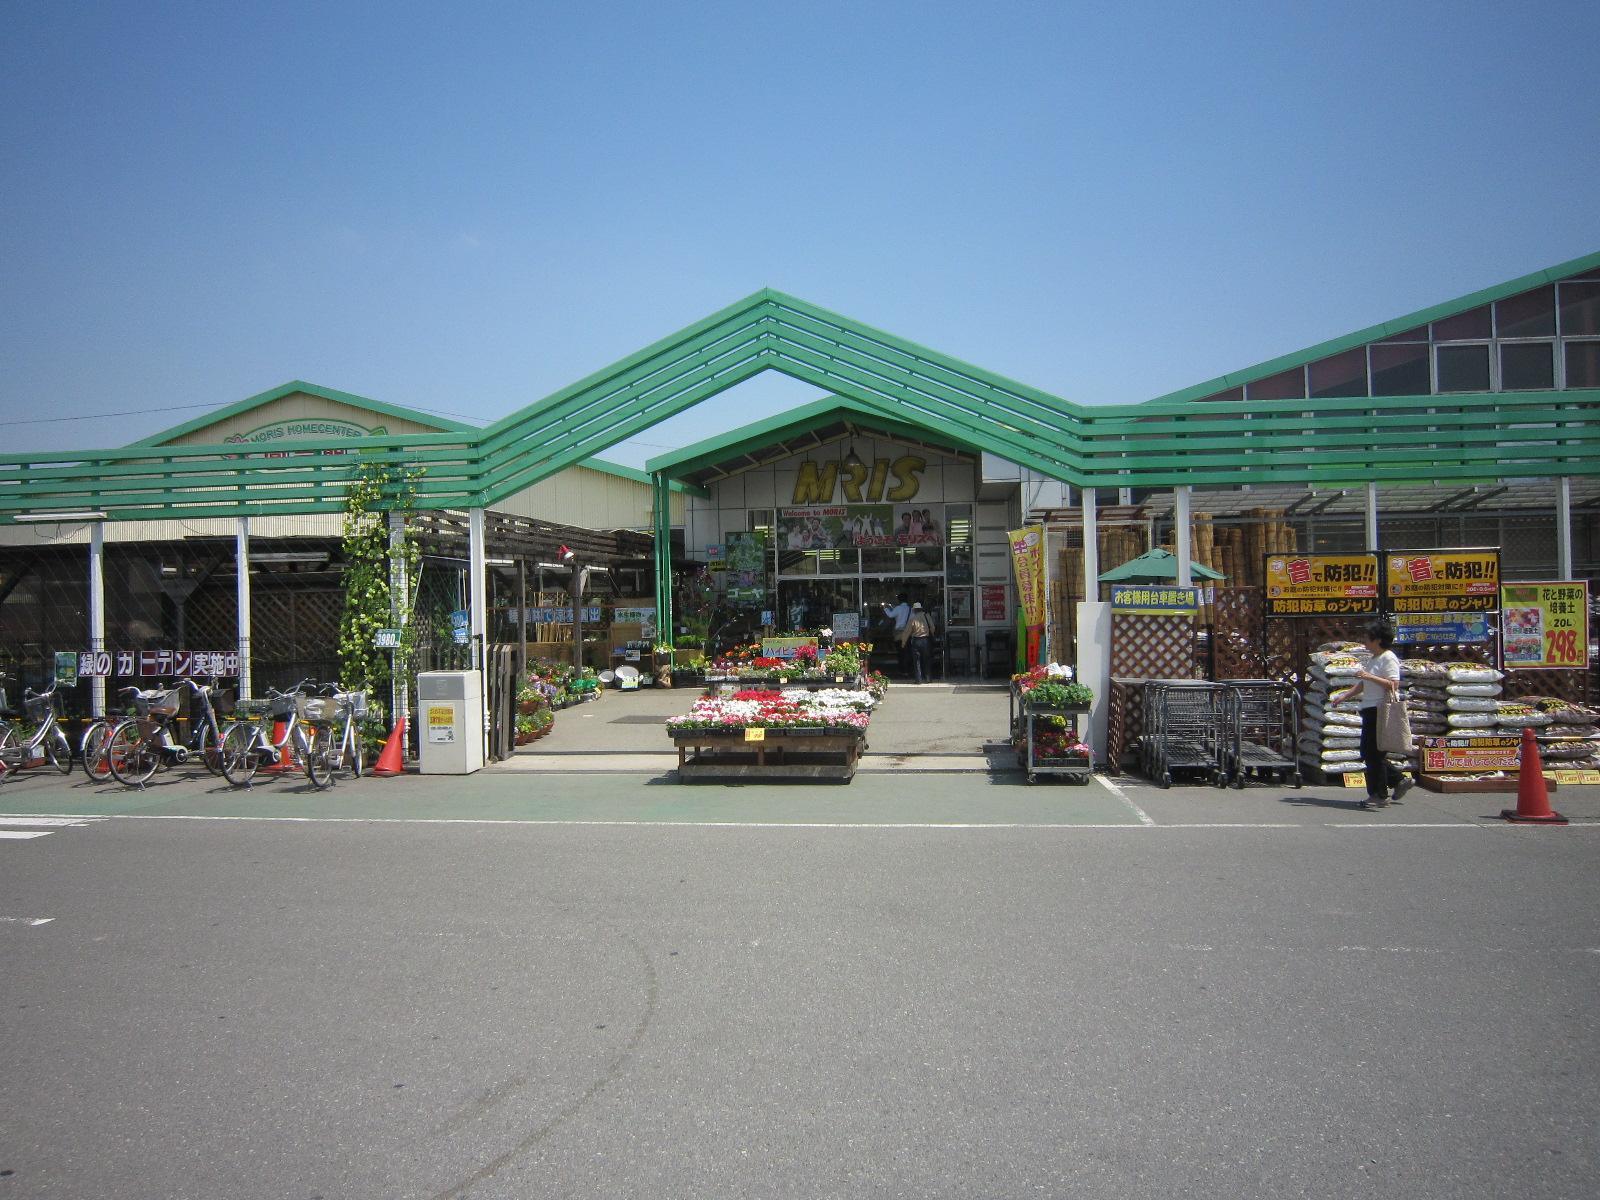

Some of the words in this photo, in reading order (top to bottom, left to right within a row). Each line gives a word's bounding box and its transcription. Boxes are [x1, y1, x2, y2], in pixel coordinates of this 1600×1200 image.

[251, 428, 284, 443] MORIS
[287, 424, 361, 437] HOMECENTER
[823, 508, 845, 516] MORIS
[1115, 590, 1195, 606] お客様用台車置き場
[1543, 588, 1584, 601] 花と野菜の
[1273, 600, 1373, 613] 防犯防草のジャリ
[1394, 597, 1494, 611] 防犯防草のジャリ
[1550, 602, 1576, 614] 培養土
[80, 652, 239, 675] 緑のカーテン実施中
